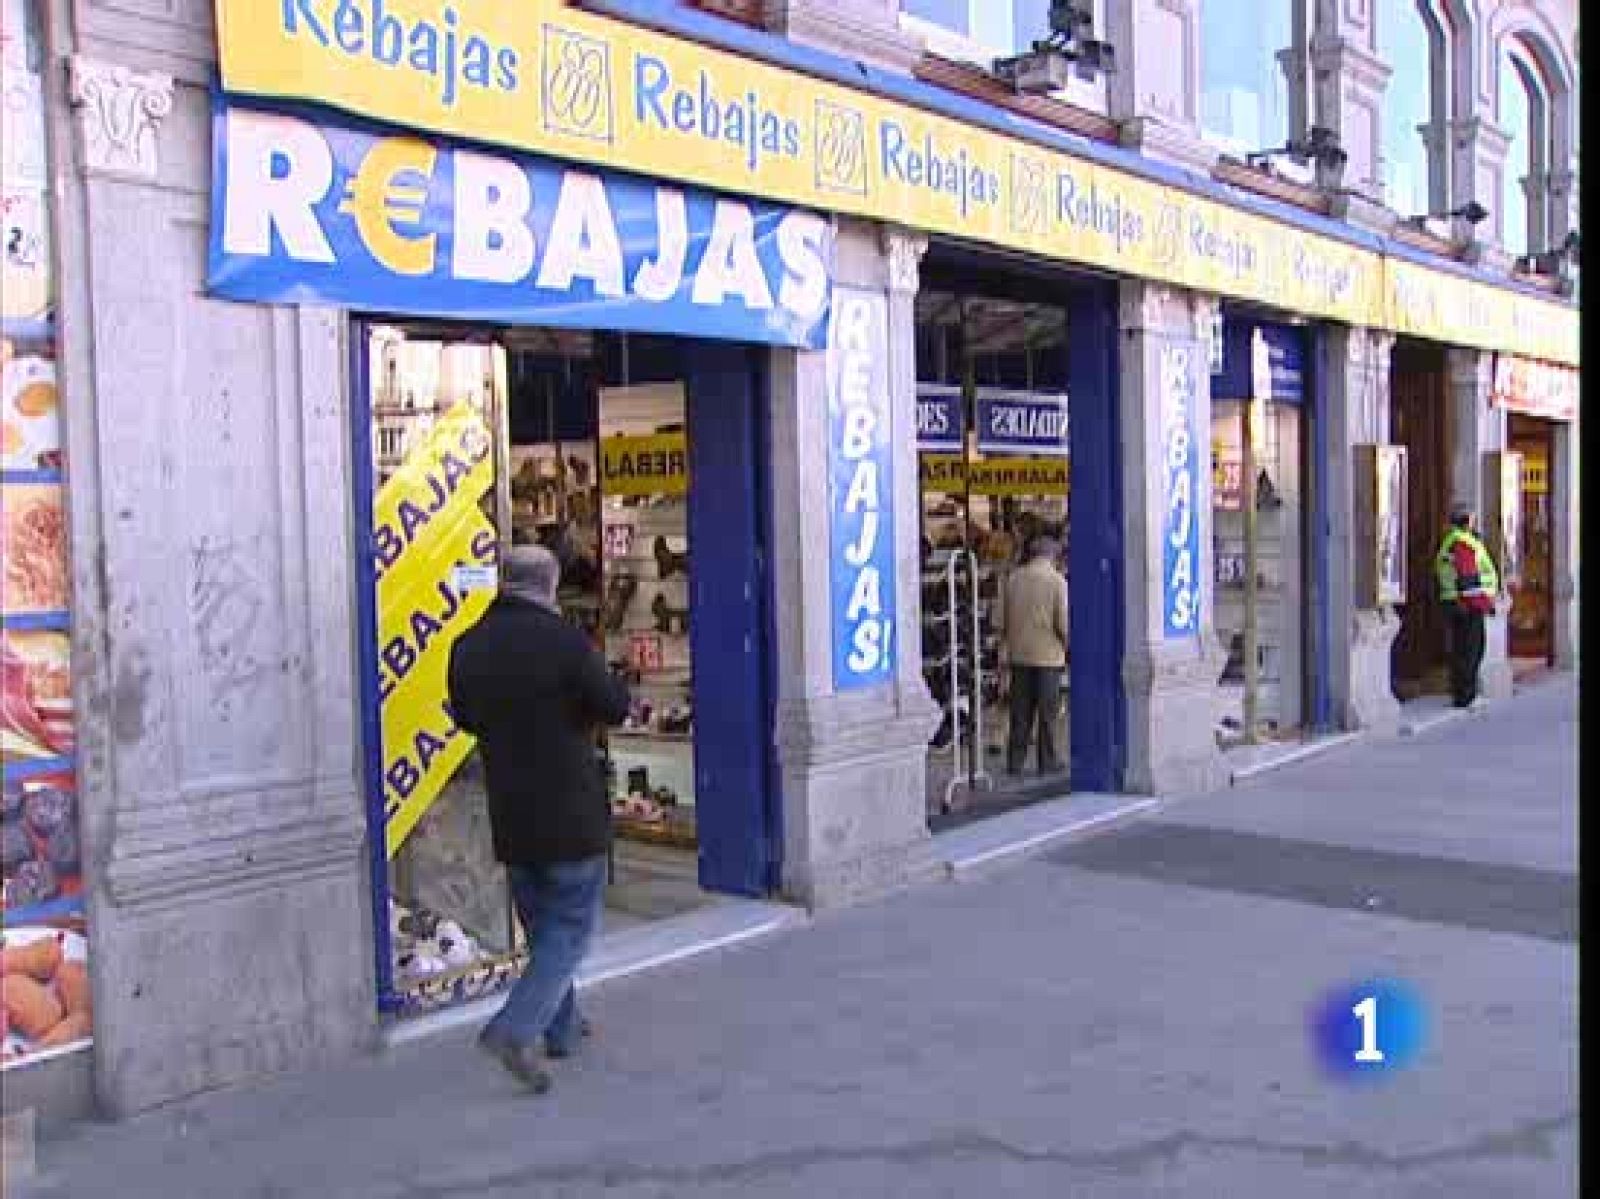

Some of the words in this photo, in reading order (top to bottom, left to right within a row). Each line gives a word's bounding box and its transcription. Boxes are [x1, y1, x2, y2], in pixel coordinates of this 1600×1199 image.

[281, 0, 519, 106] Rebajas
[633, 50, 802, 172] Rebajas
[879, 119, 998, 218] Rebajas
